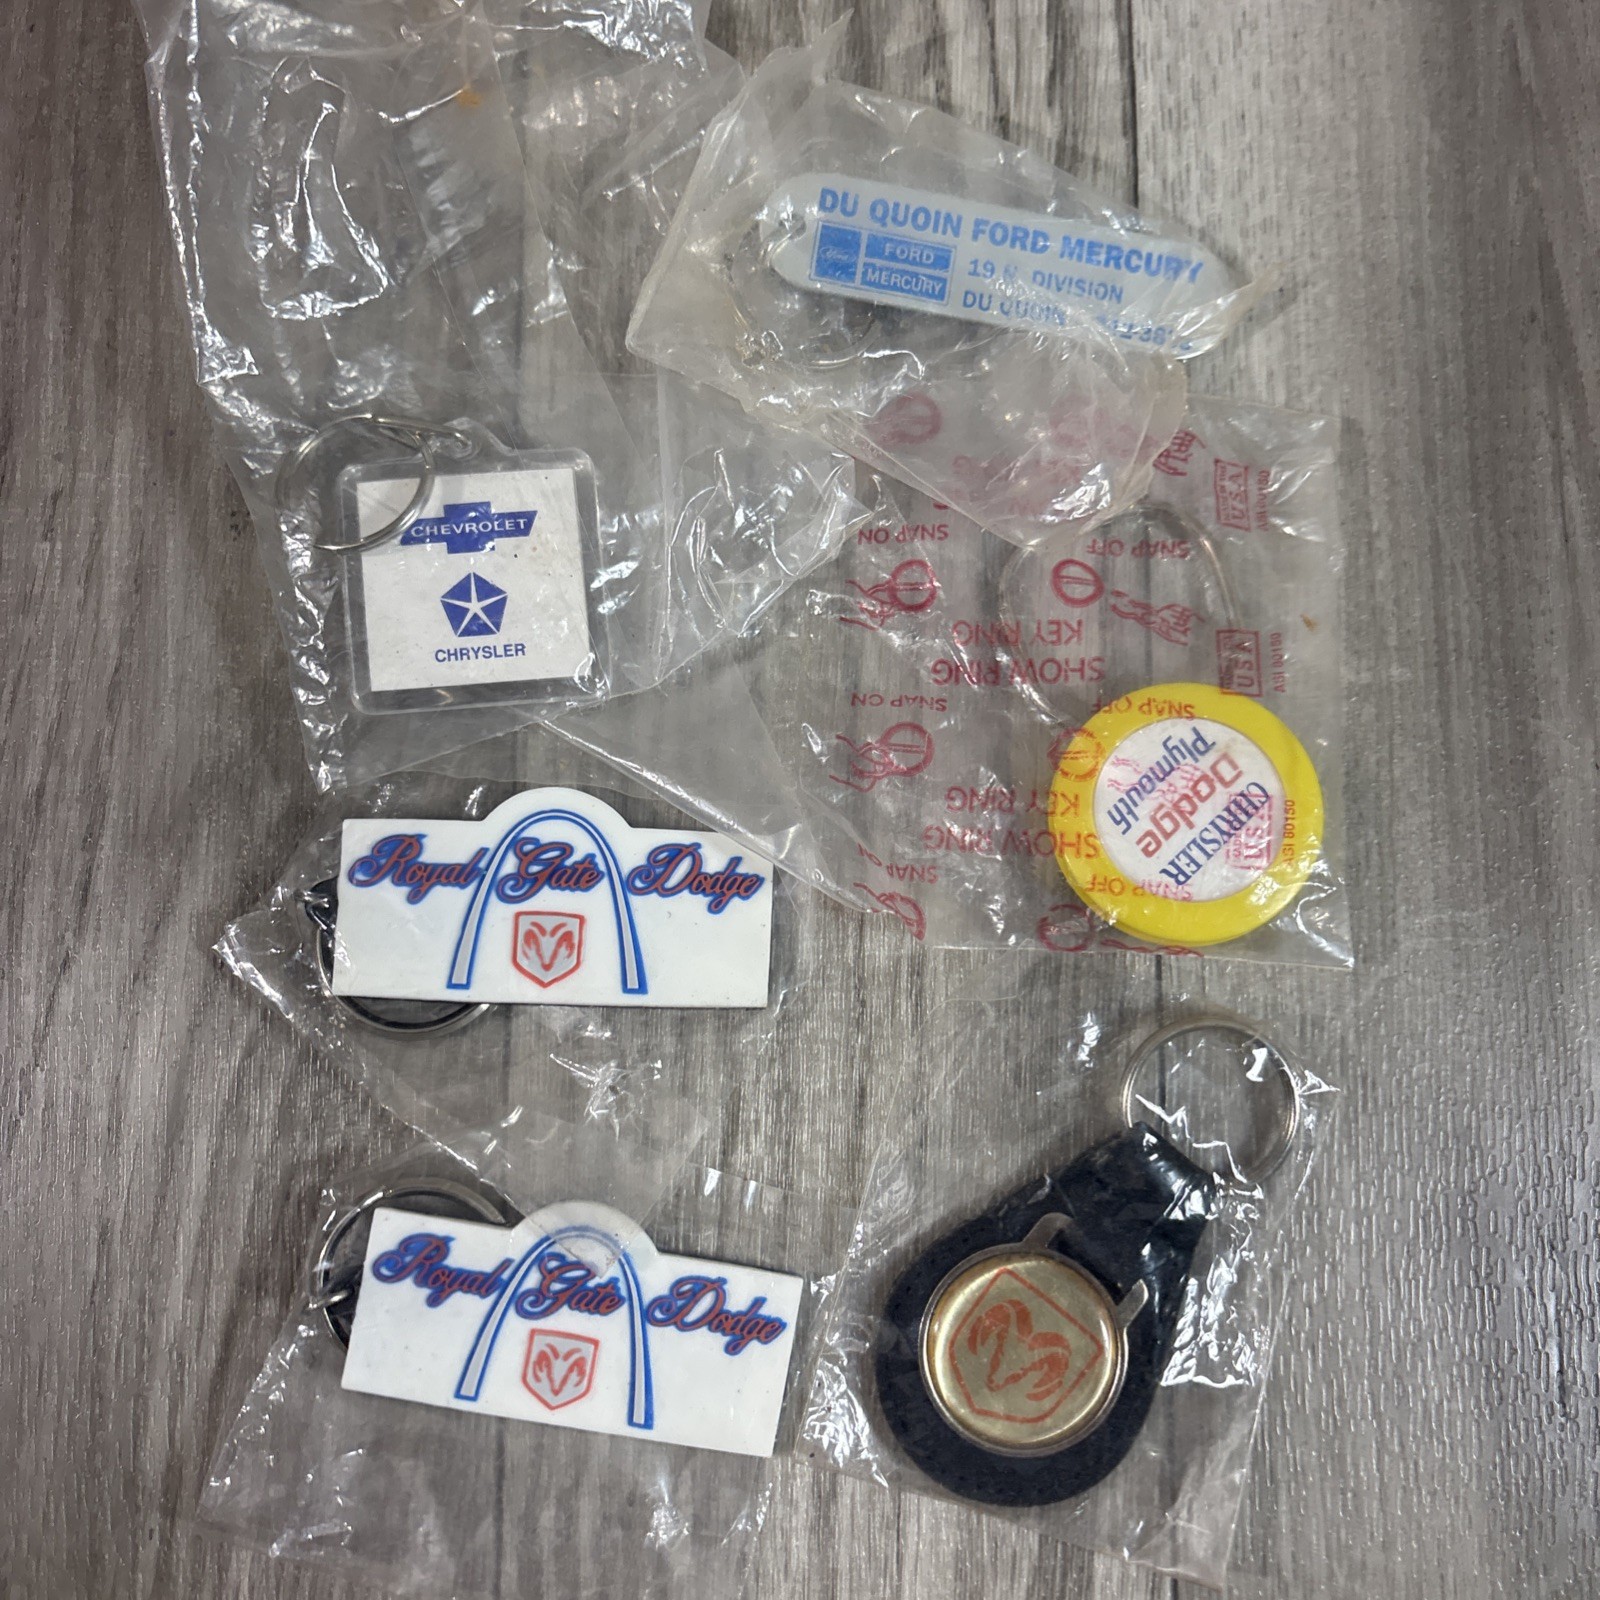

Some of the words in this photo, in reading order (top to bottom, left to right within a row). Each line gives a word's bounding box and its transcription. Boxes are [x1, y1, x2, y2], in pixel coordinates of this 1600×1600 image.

[819, 188, 859, 217] DU
[869, 198, 963, 239] QUOIN
[972, 219, 1050, 256] FORD
[1059, 235, 1204, 285] MERCURY
[884, 243, 934, 264] FORD
[866, 268, 943, 295] MERCURY
[967, 258, 996, 279] 19
[1032, 270, 1124, 304] DIVISION
[962, 289, 992, 311] DU
[411, 518, 528, 538] CHEVROLET
[858, 527, 889, 545] ON
[897, 524, 949, 543] SNAP
[1087, 538, 1125, 557] OFF
[1131, 539, 1191, 560] SNAP
[952, 619, 1021, 647] RING
[1032, 618, 1082, 647] KEY
[435, 643, 526, 663] CHRYSLER
[931, 658, 1000, 686] RING
[1010, 657, 1106, 685] SHOW
[890, 694, 947, 712] SNAP
[1138, 700, 1195, 720] SNAP
[1107, 726, 1216, 835] Plymouth
[945, 786, 1014, 813] RING
[1026, 790, 1080, 818] KEY
[1136, 752, 1243, 858] Dodge
[922, 825, 992, 853] RING
[1003, 830, 1100, 859] SHOW
[1160, 781, 1269, 886] CHRYSLER
[348, 833, 490, 905] Royal
[497, 837, 605, 903] Gate
[625, 842, 765, 915] Dodge
[886, 863, 939, 884] SNAP
[1084, 874, 1127, 894] OFF
[372, 1232, 514, 1308] Royal
[515, 1250, 627, 1320] Gate
[646, 1275, 788, 1355] Dodge
